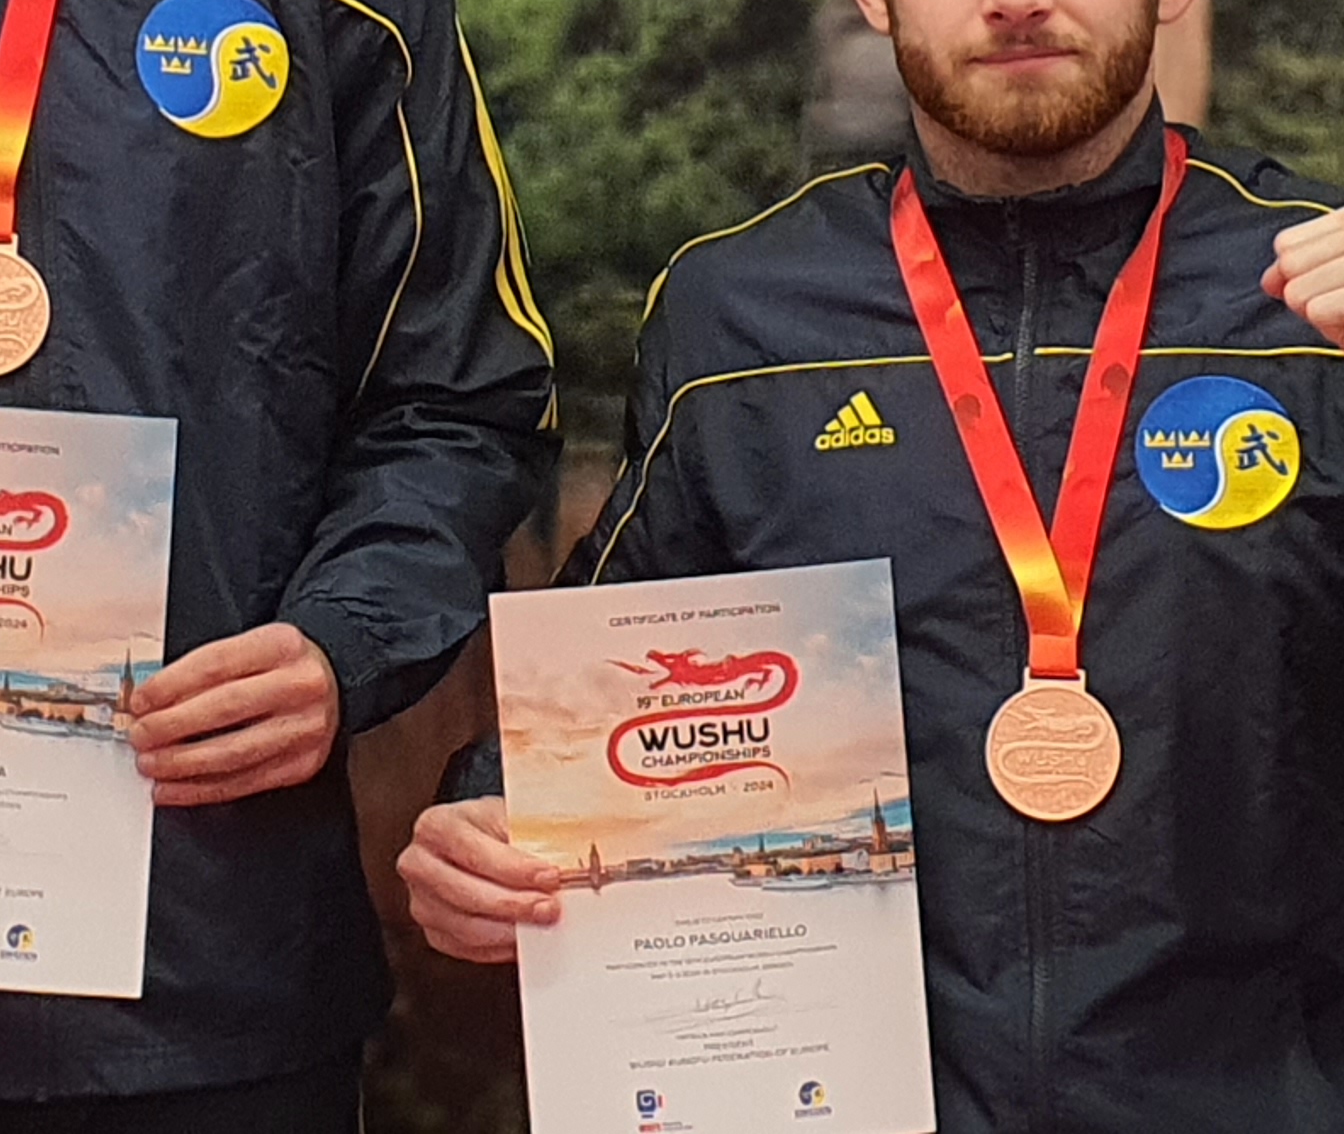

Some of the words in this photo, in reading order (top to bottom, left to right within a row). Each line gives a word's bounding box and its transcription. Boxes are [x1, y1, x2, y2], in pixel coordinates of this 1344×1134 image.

[229, 36, 277, 90] 武
[814, 426, 895, 450] adidas
[1235, 423, 1288, 476] 武
[609, 612, 677, 627] CERTIFICATE
[681, 611, 695, 621] OF
[699, 603, 781, 619] PARTICIPATION
[662, 689, 745, 707] EUROPEAN
[638, 717, 770, 752] WUSHU
[641, 746, 771, 768] CHAMPIONSHIPS
[644, 784, 726, 801] STOCKHOLM
[634, 936, 685, 951] PAOLO
[689, 924, 807, 947] PASQUARIELLO
